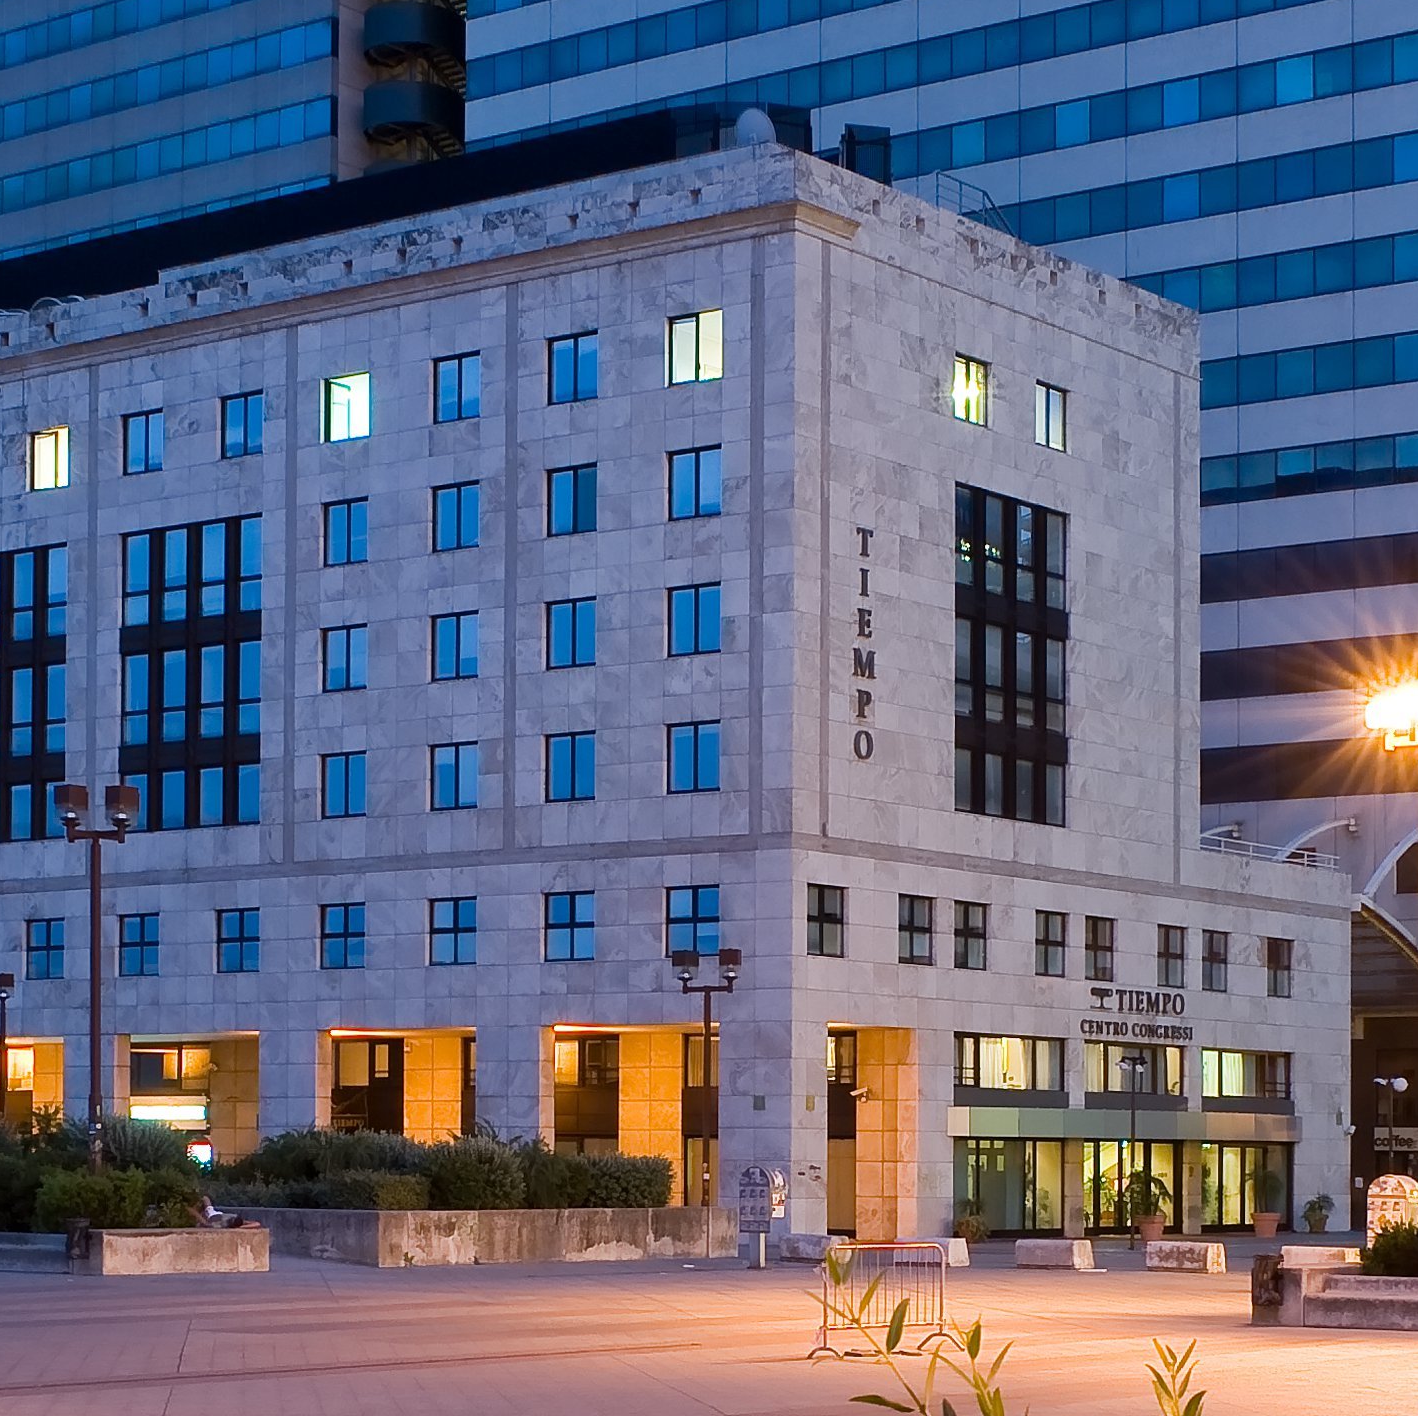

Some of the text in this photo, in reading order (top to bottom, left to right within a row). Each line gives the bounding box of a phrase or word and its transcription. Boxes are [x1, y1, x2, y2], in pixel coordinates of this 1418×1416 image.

[852, 527, 877, 760] TIEMPO
[1115, 989, 1185, 1015] TIEMPO
[1080, 1019, 1194, 1040] CENTRO CONGRESSI
